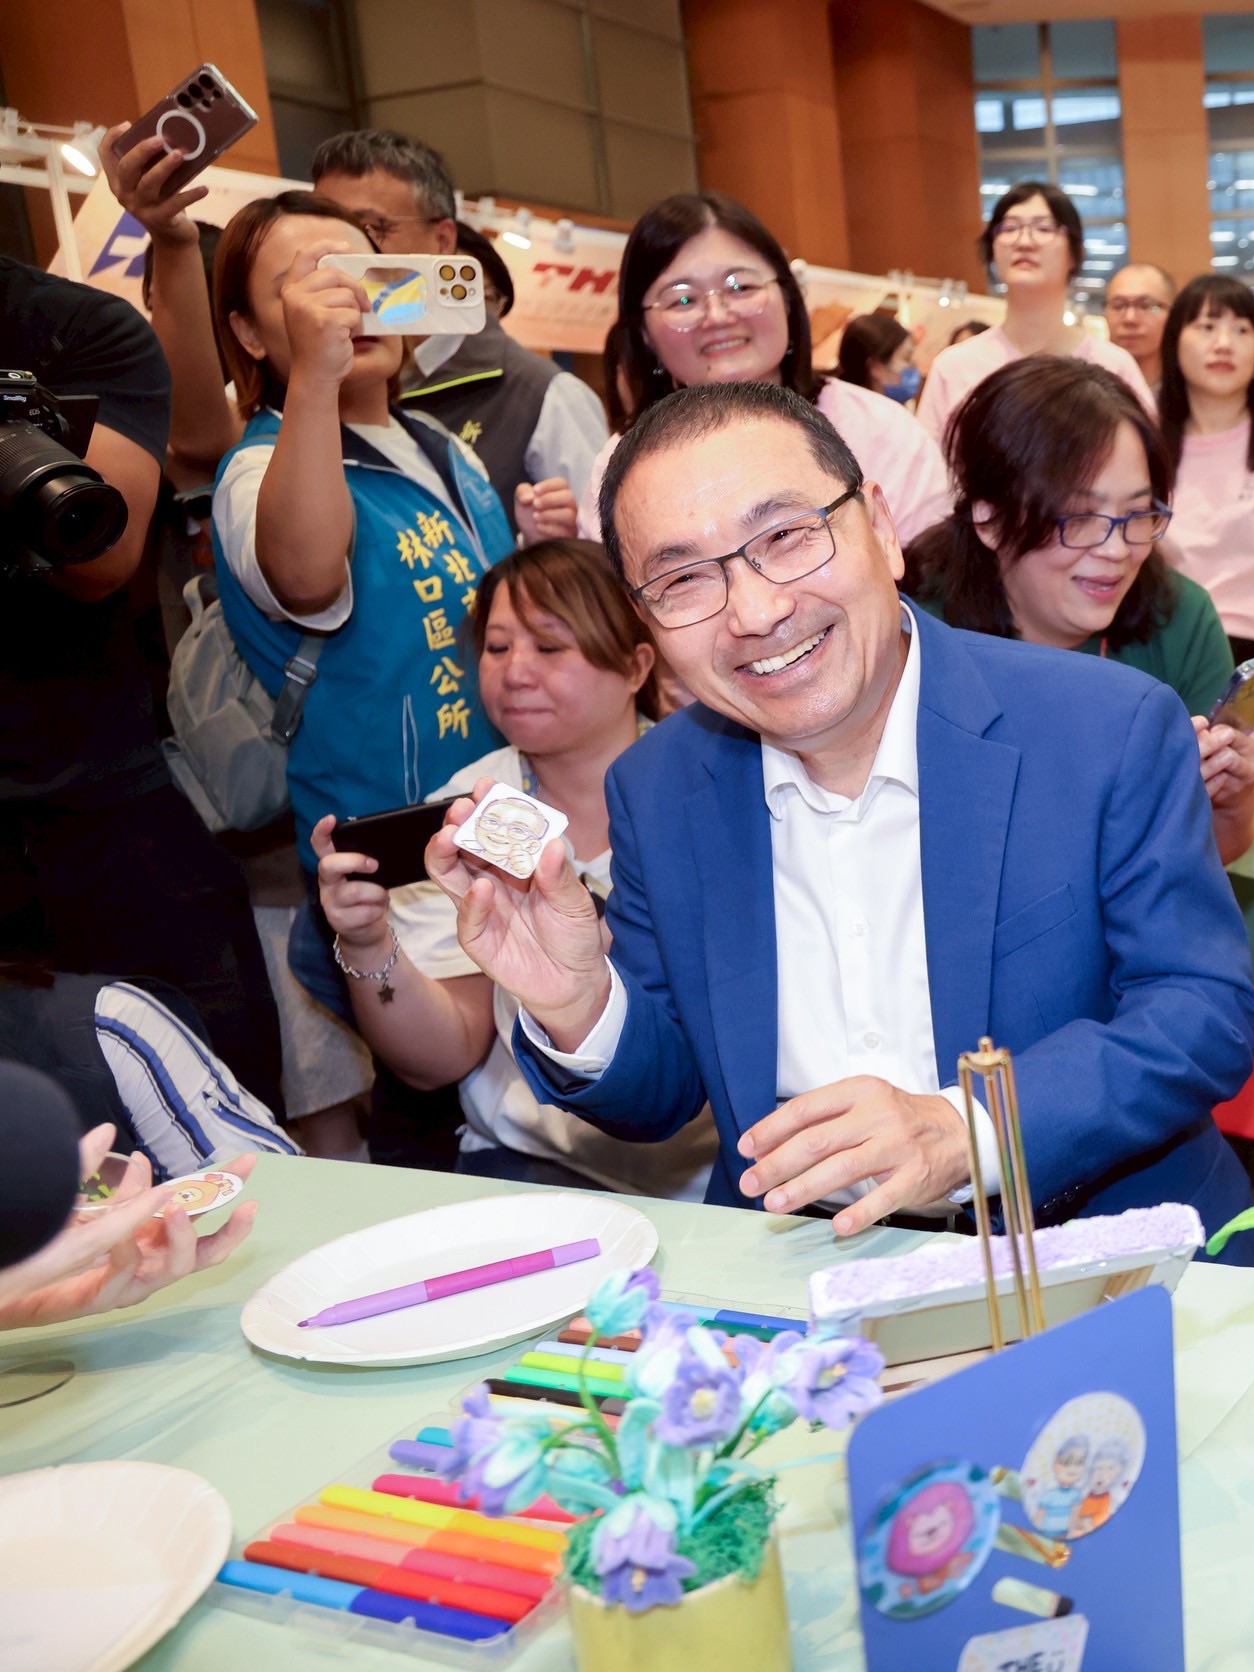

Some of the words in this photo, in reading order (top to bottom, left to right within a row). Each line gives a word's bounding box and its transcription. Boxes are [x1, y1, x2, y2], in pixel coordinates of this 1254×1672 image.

[396, 528, 471, 740] 林口區公所
